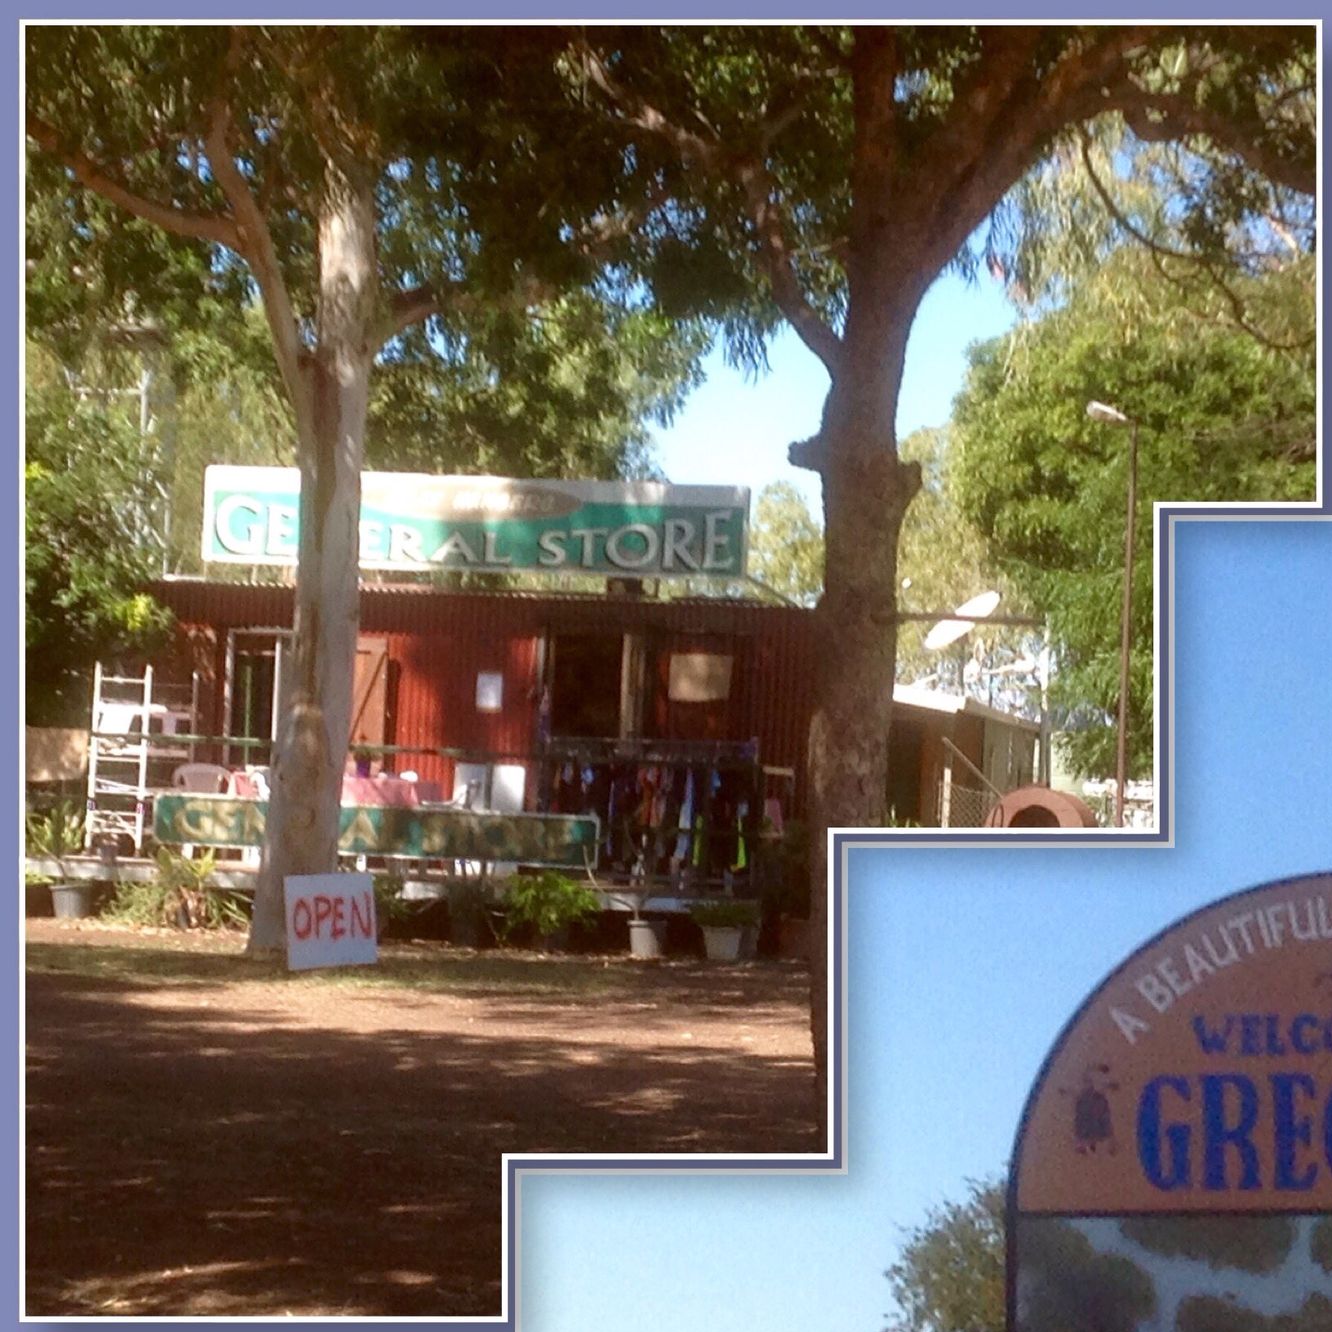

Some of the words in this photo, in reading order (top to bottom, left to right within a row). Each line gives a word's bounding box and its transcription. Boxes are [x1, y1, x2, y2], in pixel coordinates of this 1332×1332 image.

[214, 493, 511, 565] GEERAL
[538, 509, 733, 571] STORE
[292, 891, 373, 941] OPEN
[1108, 1004, 1150, 1046] A
